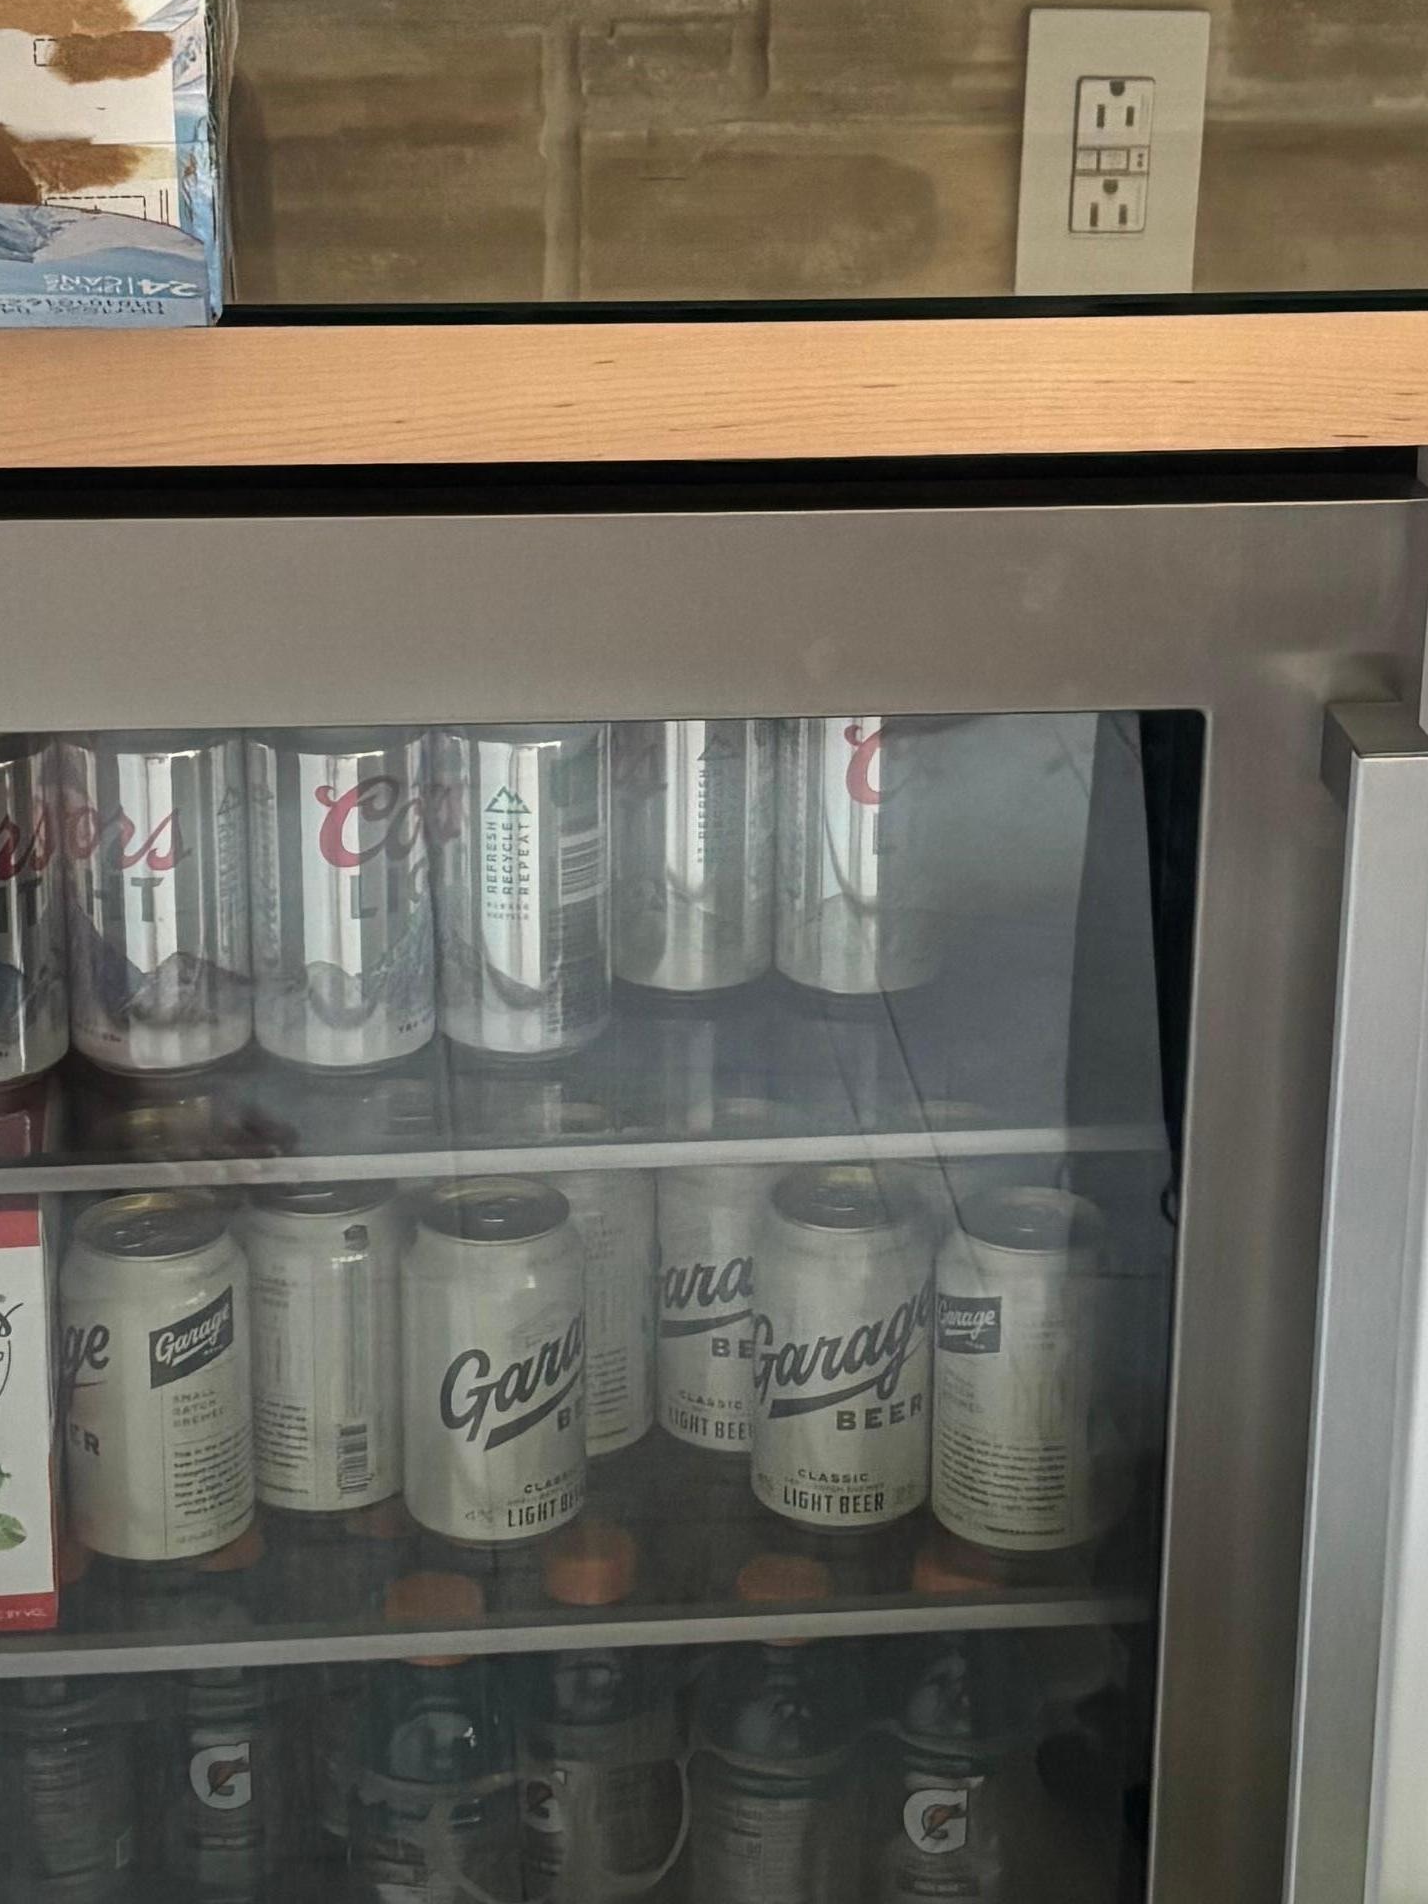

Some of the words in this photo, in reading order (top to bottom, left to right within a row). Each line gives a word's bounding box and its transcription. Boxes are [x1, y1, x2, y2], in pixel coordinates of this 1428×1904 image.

[138, 280, 197, 297] 24
[502, 822, 513, 895] RECYCLE
[518, 822, 529, 895] REPEAT
[155, 1302, 230, 1364] Garage
[711, 1337, 755, 1358] BE
[836, 1393, 922, 1431] BEER
[797, 1468, 869, 1484] CLASSIC
[508, 1498, 556, 1528] LIGHT
[783, 1485, 833, 1514] LIGHT
[839, 1491, 884, 1514] BEER
[189, 1742, 252, 1810] G
[903, 1788, 969, 1854] G
